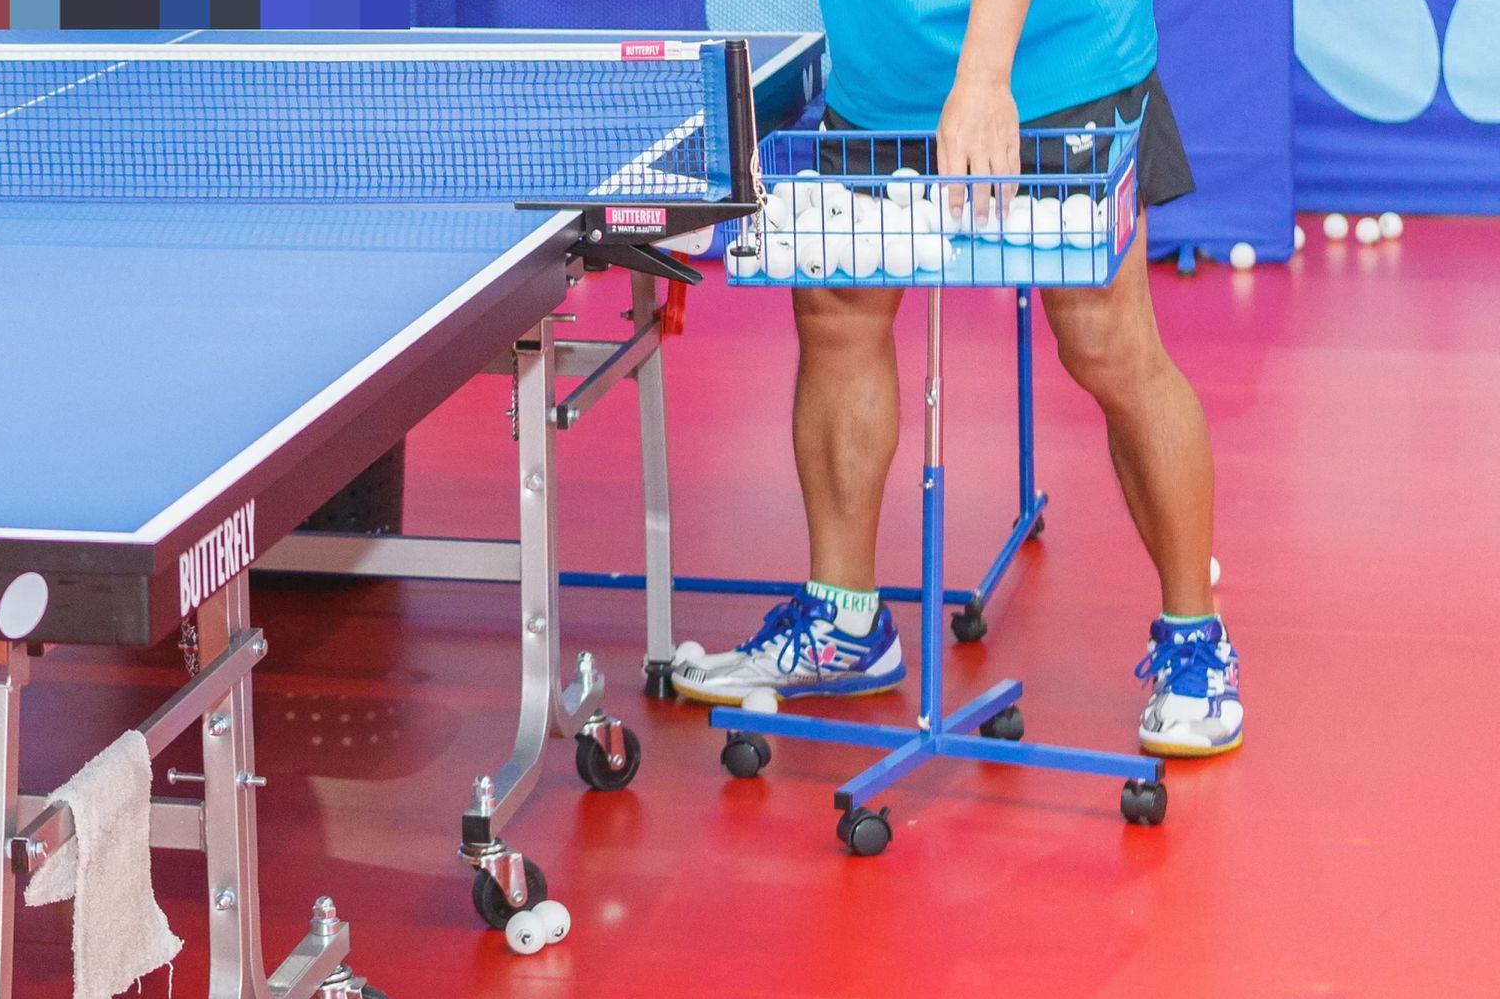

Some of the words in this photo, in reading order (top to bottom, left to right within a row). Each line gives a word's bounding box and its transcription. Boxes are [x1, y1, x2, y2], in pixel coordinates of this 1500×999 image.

[626, 45, 660, 56] BUTTERFLY
[611, 209, 661, 225] BUTTERFLY
[180, 498, 255, 617] BUTTERFLY
